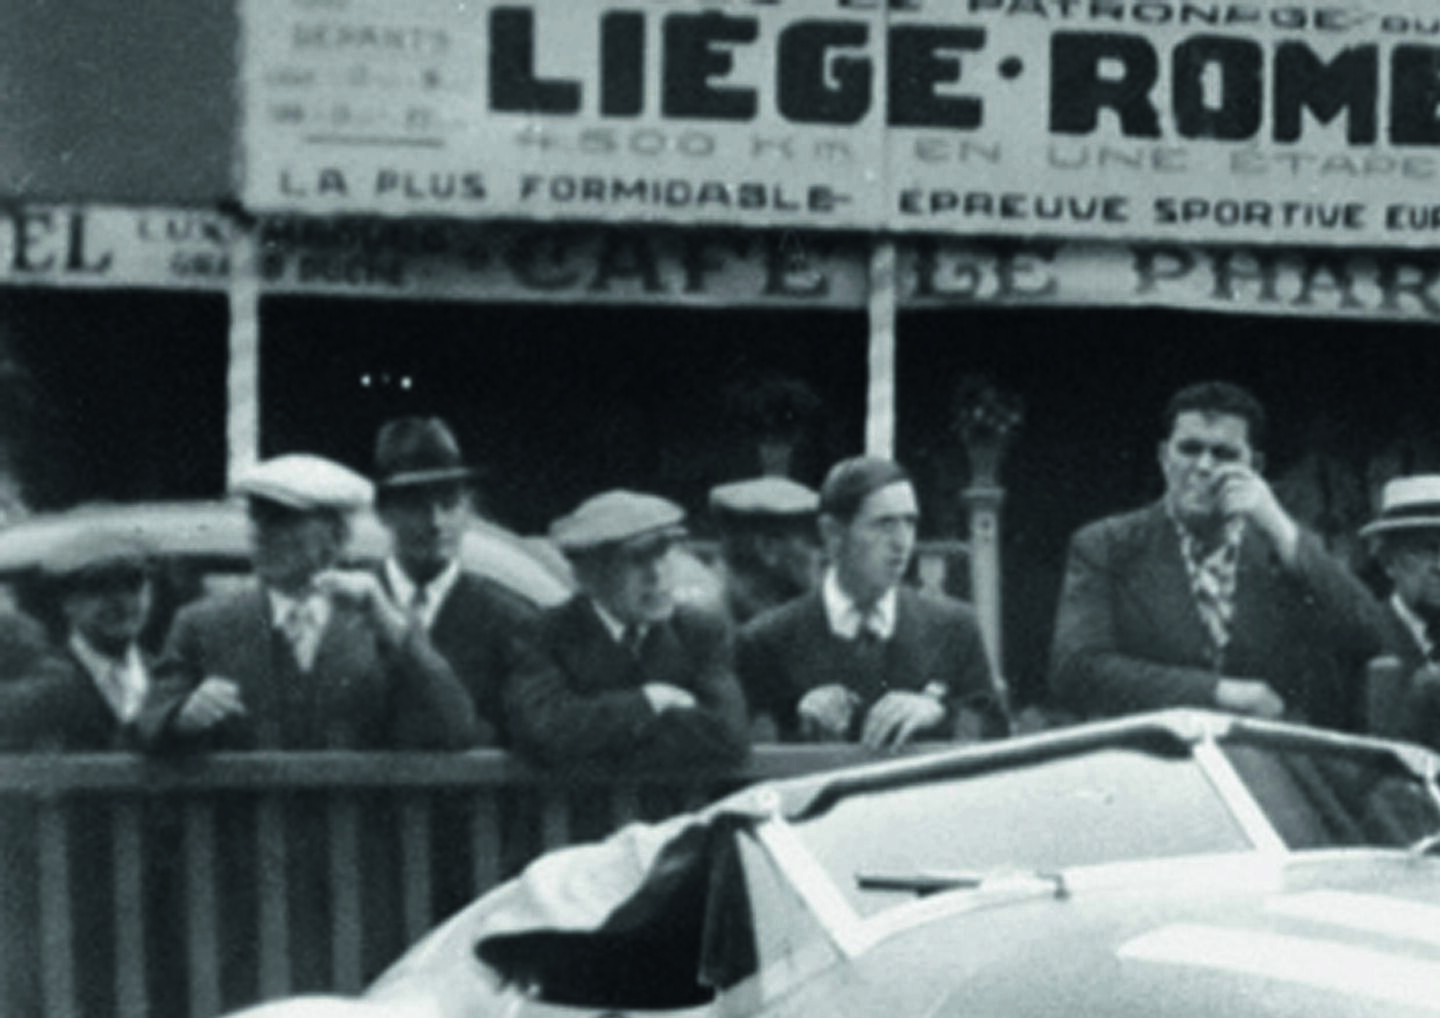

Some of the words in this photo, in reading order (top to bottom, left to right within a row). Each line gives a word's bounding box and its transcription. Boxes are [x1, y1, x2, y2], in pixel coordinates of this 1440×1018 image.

[914, 137, 1003, 164] EN
[1047, 146, 1189, 173] UNE
[279, 169, 349, 198] LA
[375, 170, 488, 200] PLUS
[1153, 197, 1366, 229] SPORTIVE
